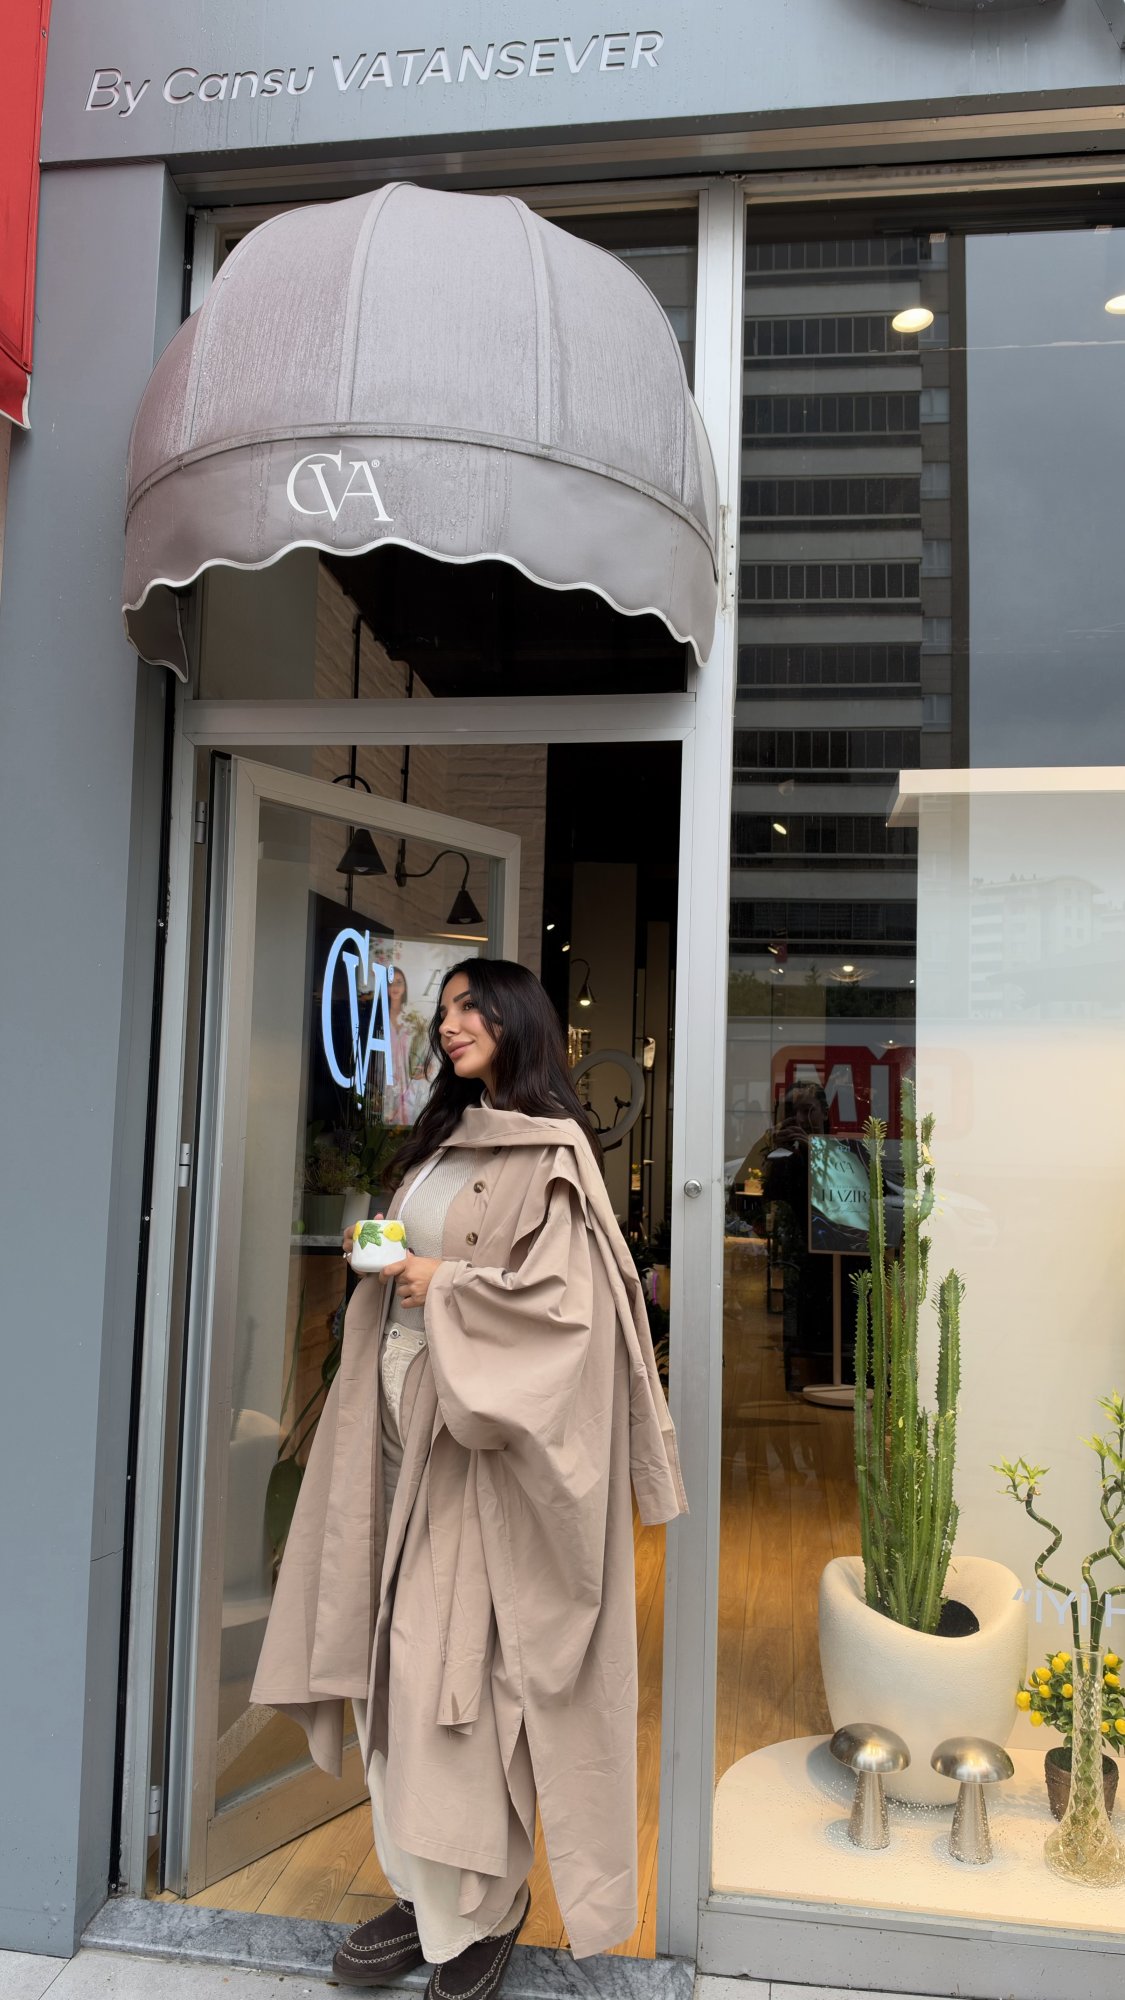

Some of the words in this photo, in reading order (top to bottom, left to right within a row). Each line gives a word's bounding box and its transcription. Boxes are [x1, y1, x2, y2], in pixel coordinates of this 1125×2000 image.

[84, 67, 151, 118] By
[162, 66, 315, 105] Cansu
[332, 30, 665, 92] VATANSEVER
